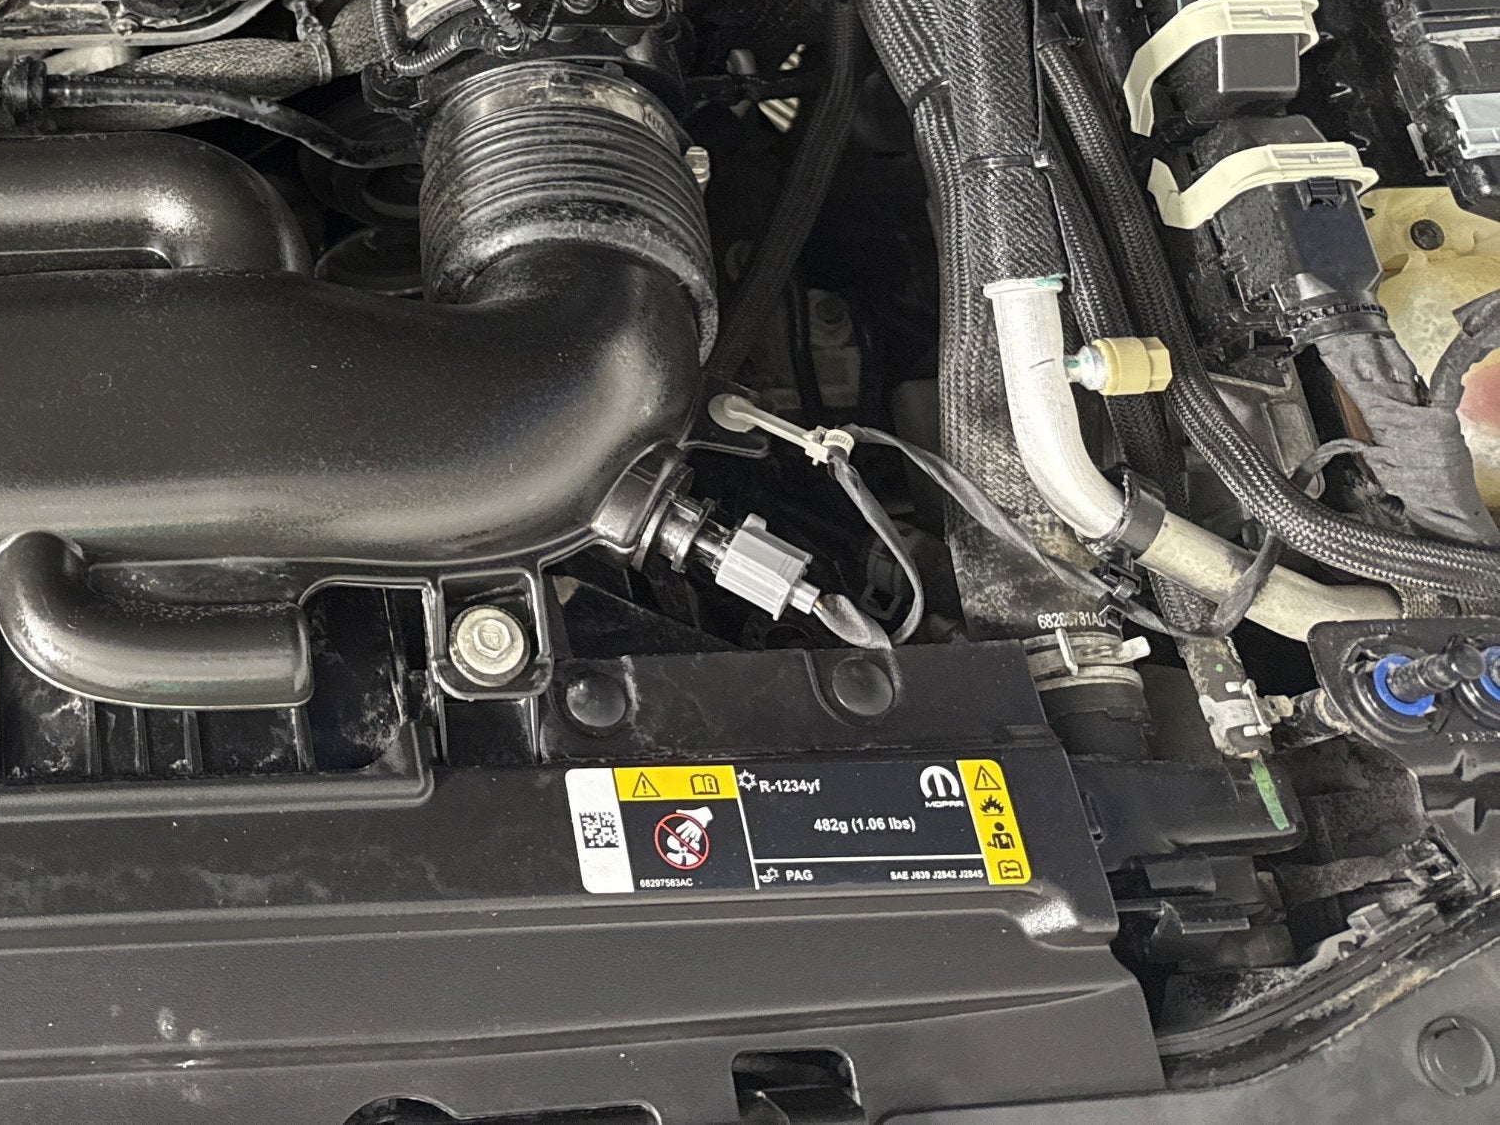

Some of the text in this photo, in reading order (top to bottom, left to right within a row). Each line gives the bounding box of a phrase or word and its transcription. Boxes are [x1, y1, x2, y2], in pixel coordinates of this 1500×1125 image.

[759, 779, 821, 794] R-1234yf
[814, 817, 916, 833] 482g (1.06 lbs)
[786, 870, 813, 881] PAG
[890, 869, 983, 880] SAE J639 J2842 J2845
[640, 877, 694, 888] 68297583AC
